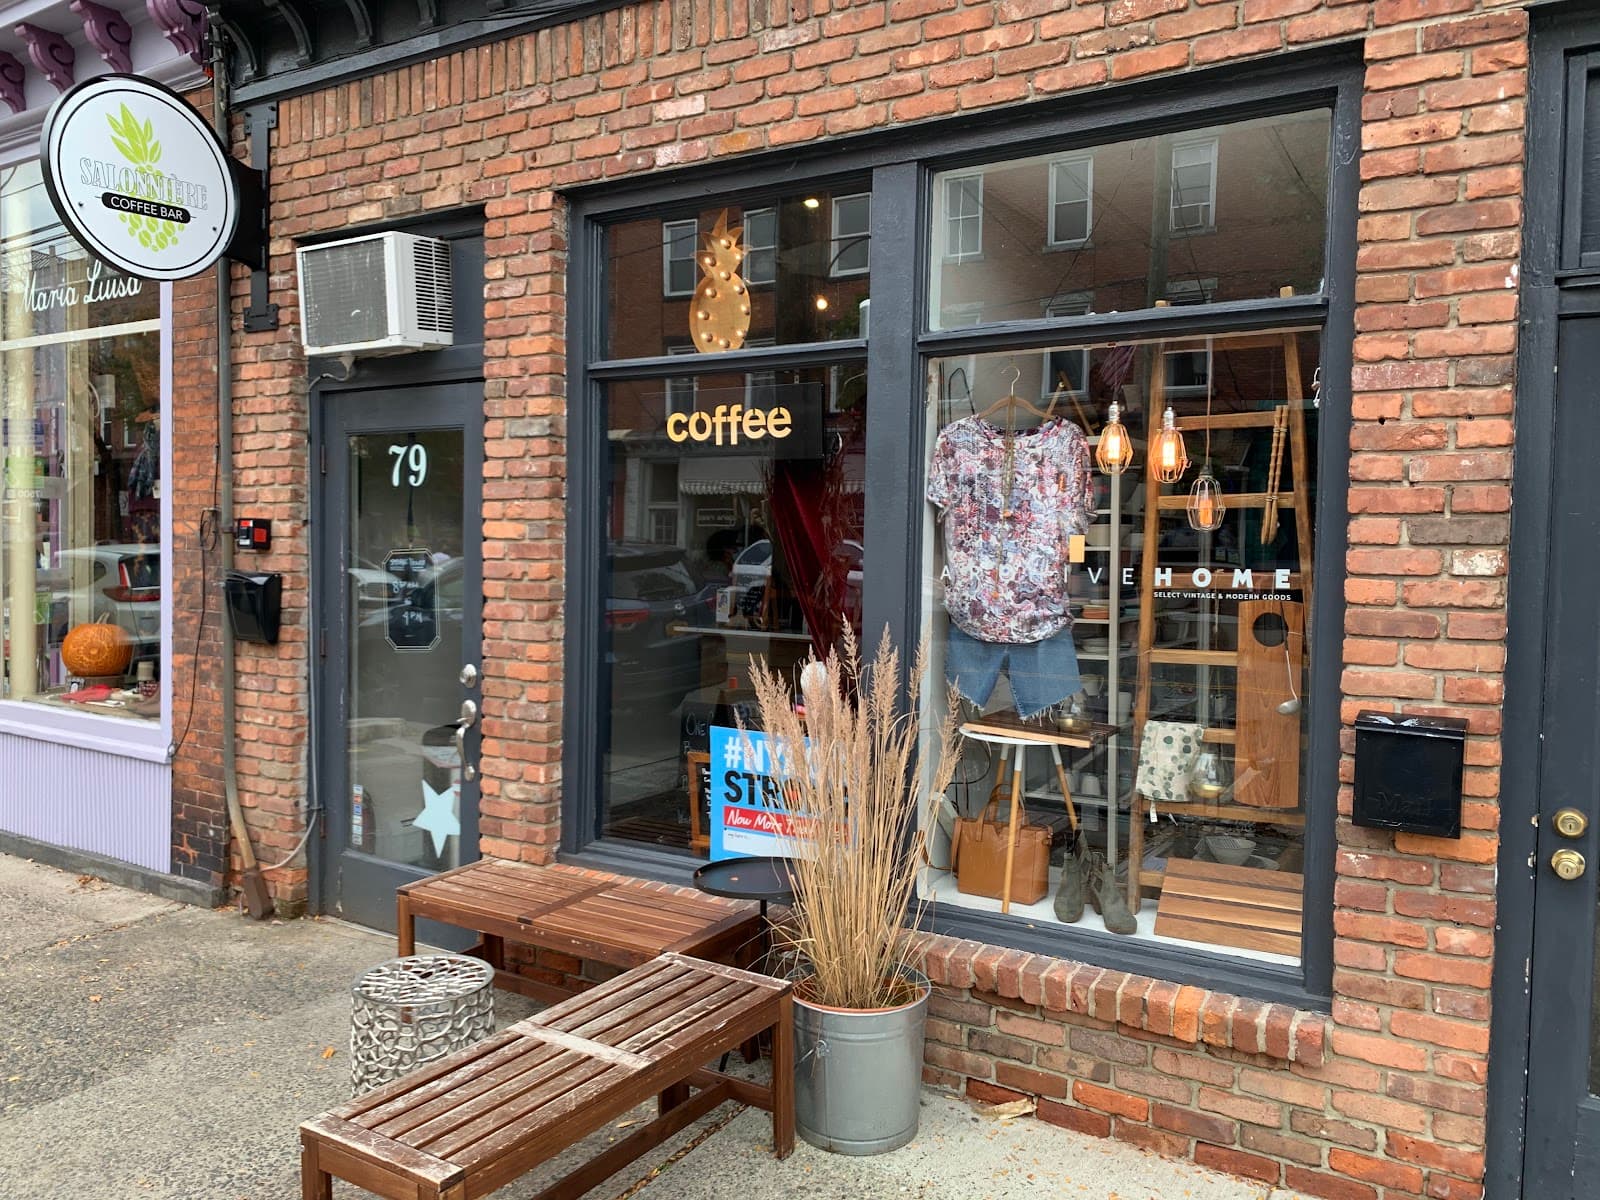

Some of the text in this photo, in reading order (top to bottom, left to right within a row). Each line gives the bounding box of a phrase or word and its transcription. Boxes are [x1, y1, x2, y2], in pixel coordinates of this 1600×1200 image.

[79, 157, 208, 211] SALONNIÈRE
[110, 196, 183, 221] COFFEE BAR
[16, 259, 143, 313] Maria Luisa
[666, 404, 793, 446] coffee
[388, 444, 428, 488] 79
[1154, 567, 1291, 589] HOME
[1153, 591, 1181, 599] SELECT
[1262, 593, 1292, 601] GOODS
[726, 808, 752, 826] Now
